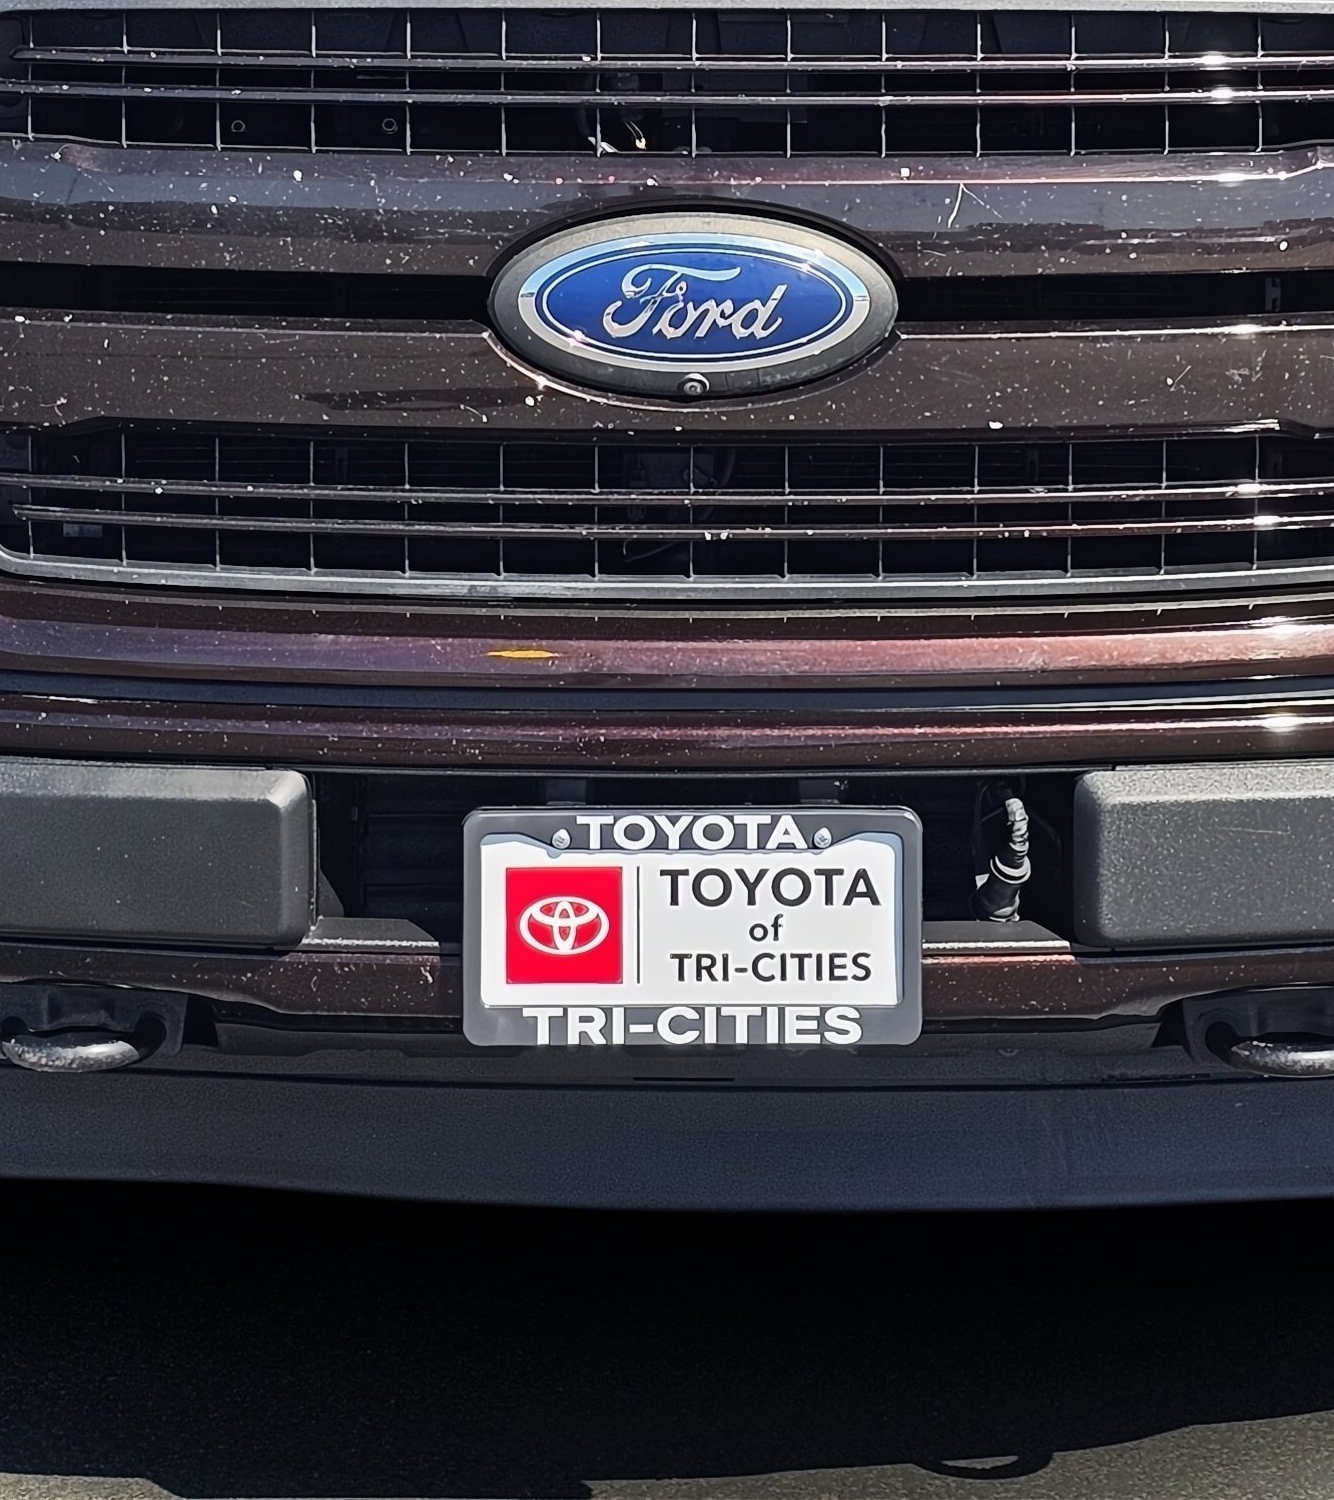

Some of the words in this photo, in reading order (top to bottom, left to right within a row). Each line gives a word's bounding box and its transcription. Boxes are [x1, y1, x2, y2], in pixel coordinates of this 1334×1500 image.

[602, 263, 788, 339] Ford
[576, 815, 808, 850] TOYOTA
[660, 867, 881, 907] TOYOTA
[748, 914, 784, 942] of
[670, 952, 872, 982] TRI-CITIES
[522, 1006, 863, 1045] TRI-CITIES
